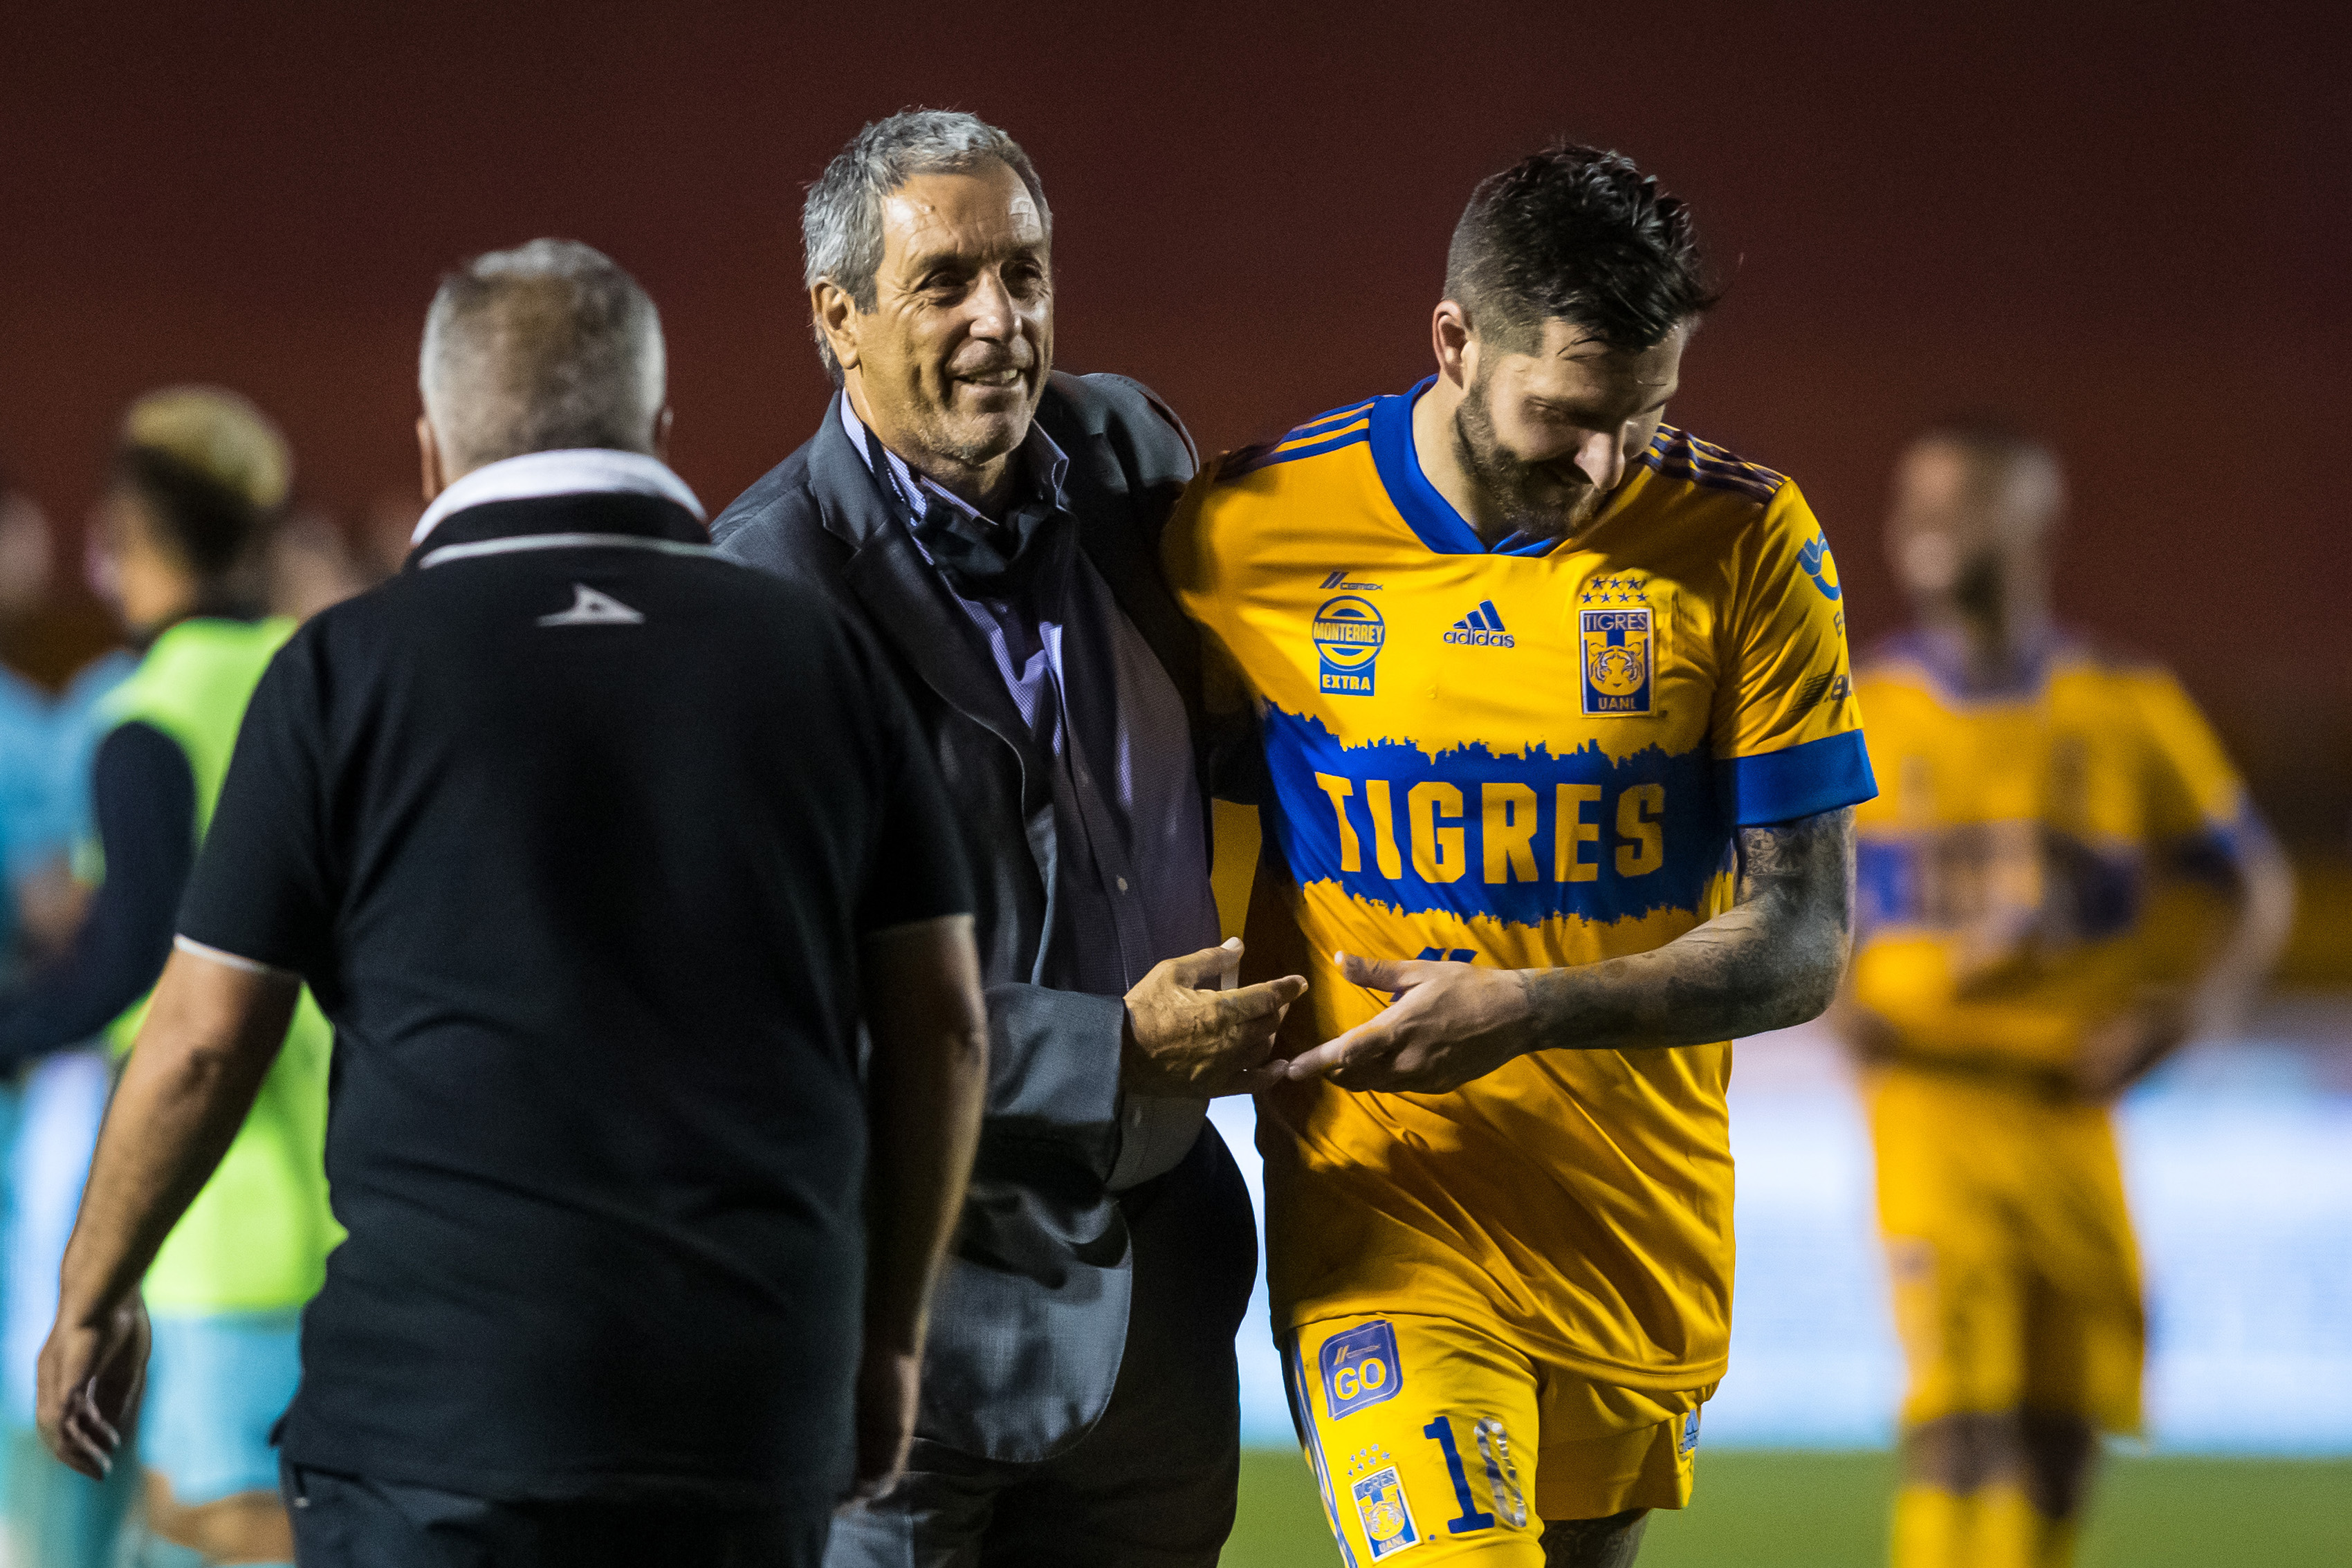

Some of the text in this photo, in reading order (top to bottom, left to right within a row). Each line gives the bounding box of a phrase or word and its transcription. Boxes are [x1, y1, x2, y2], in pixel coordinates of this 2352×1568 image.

[1584, 613, 1647, 631] TIGRES
[1314, 622, 1384, 643] MONTERREY
[1443, 629, 1515, 648] adidas
[1322, 674, 1371, 690] EXTRA
[1598, 697, 1637, 710] UANL
[1314, 771, 1665, 885] TIGRES
[1334, 1357, 1386, 1400] GO
